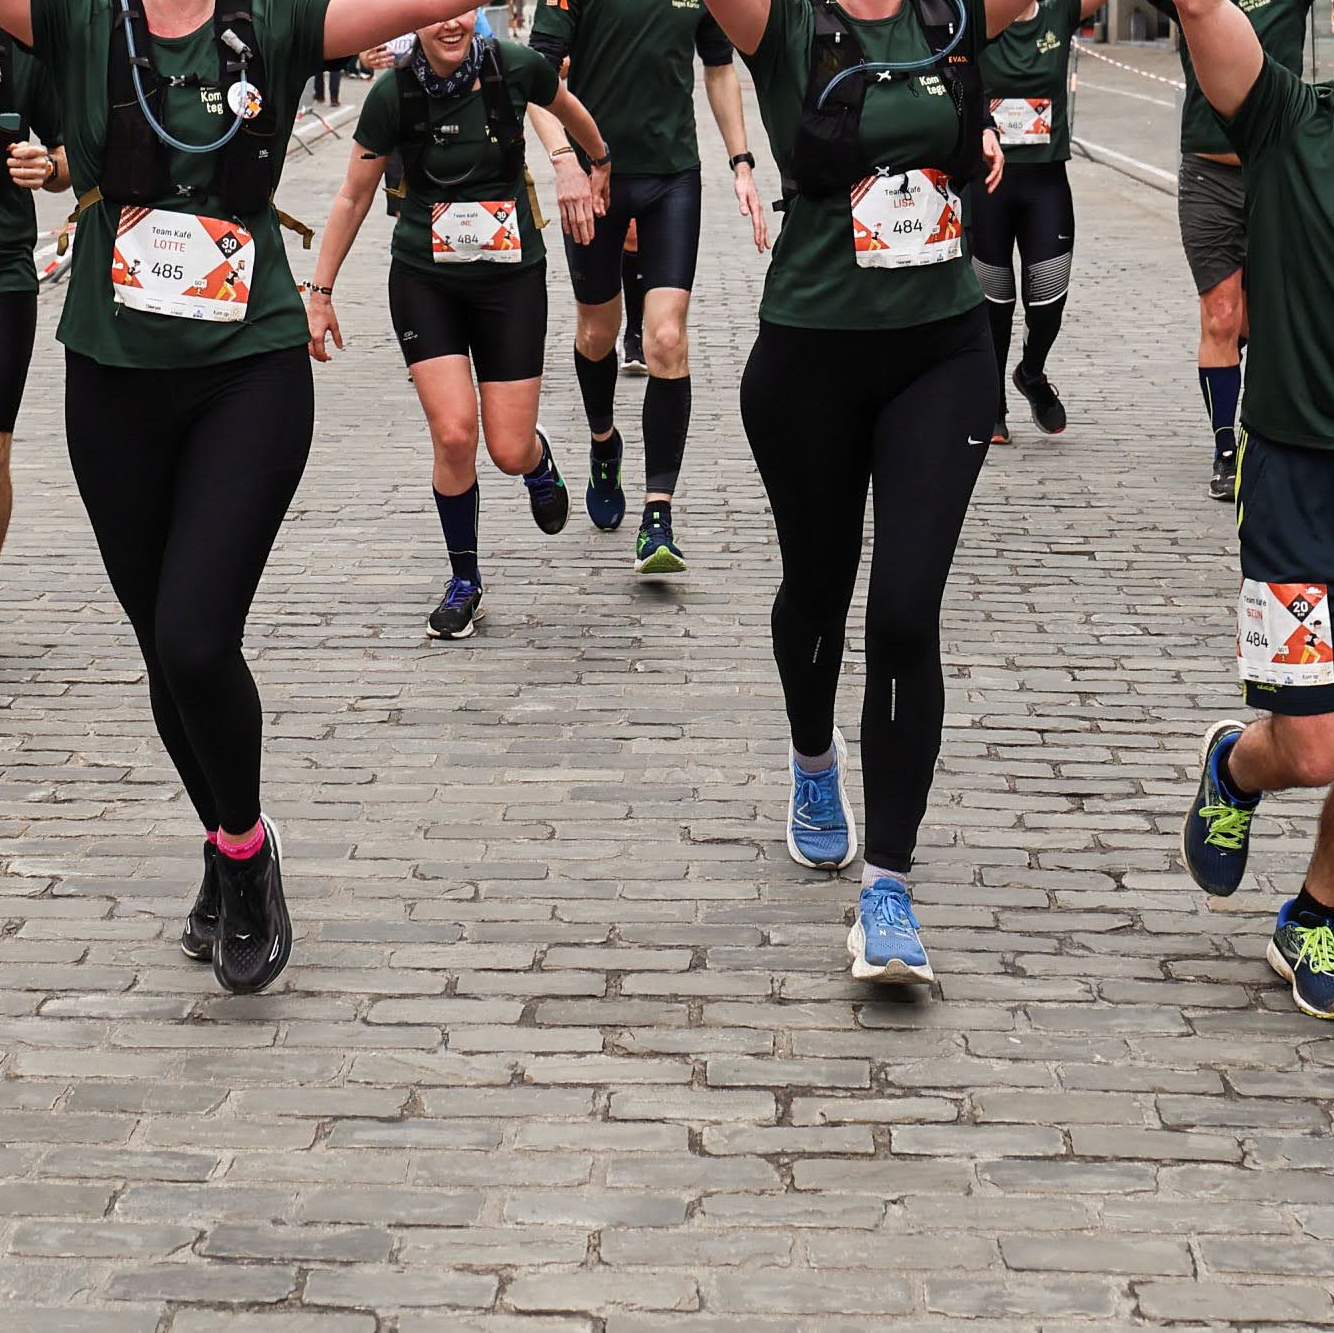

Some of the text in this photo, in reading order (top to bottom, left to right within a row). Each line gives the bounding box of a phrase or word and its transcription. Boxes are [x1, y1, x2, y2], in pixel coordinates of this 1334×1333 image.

[919, 75, 939, 86] Kom
[201, 91, 222, 102] Kom
[893, 198, 915, 208] LISA
[152, 227, 171, 236] Team
[893, 219, 923, 234] 484
[153, 237, 238, 252] LOTTE 30
[457, 234, 479, 244] 484
[151, 262, 184, 280] 485
[1292, 601, 1308, 613] 20
[1246, 630, 1269, 648] 484
